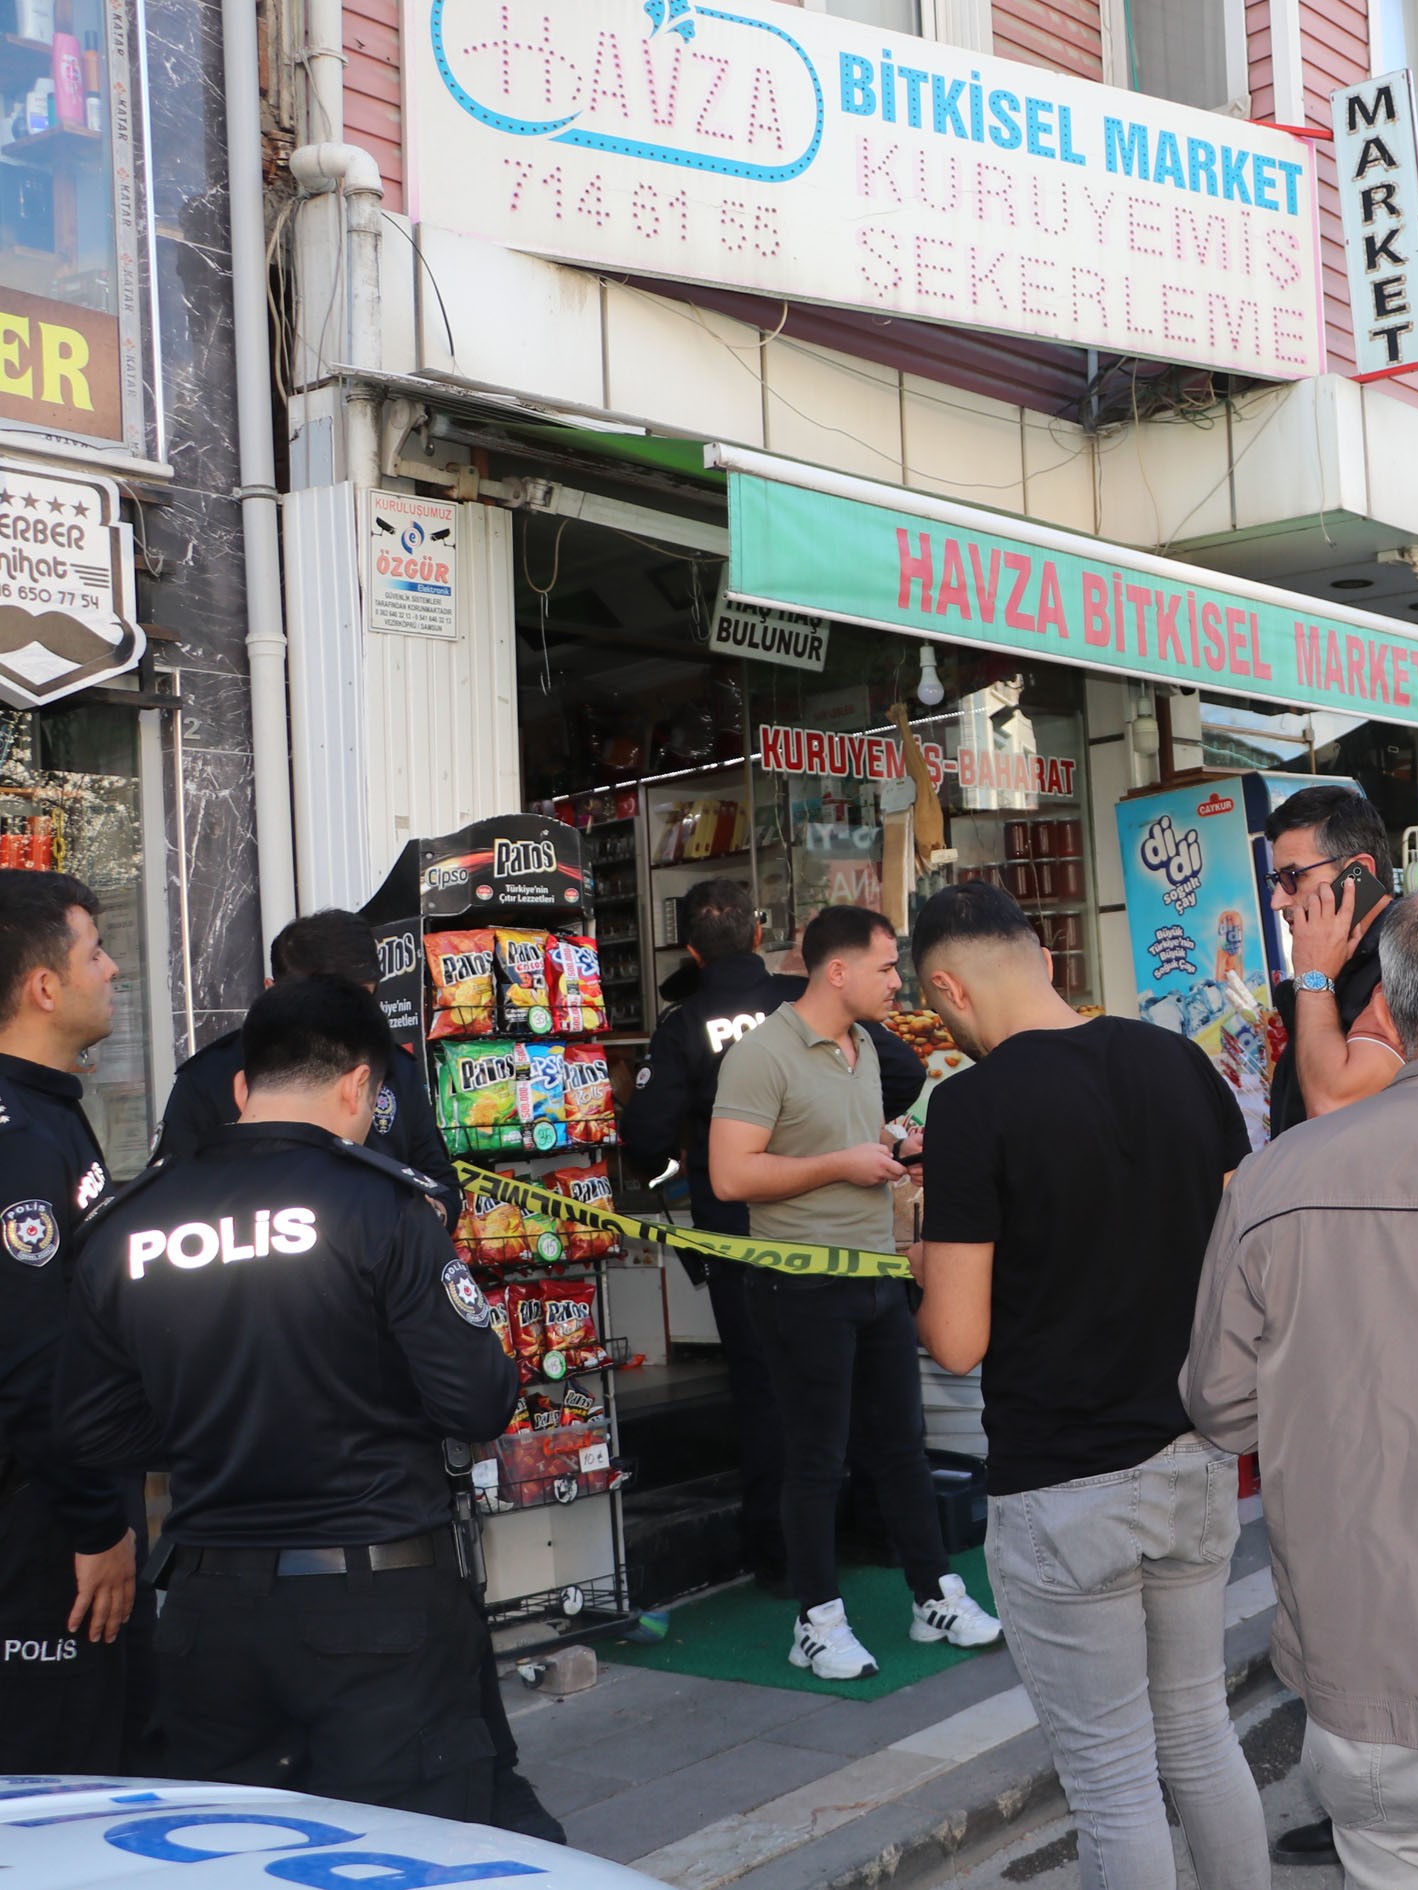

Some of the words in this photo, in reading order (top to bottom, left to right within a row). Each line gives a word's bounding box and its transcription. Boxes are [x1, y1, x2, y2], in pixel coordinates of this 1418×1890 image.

[461, 2, 785, 150] HAVZA
[839, 48, 1086, 167] BİTKİSEL
[1103, 115, 1303, 216] MARKET
[502, 158, 611, 226] 714
[719, 199, 780, 257] 55
[1345, 83, 1415, 366] MARKET
[375, 498, 452, 520] KURULUŞUMUZ
[376, 549, 449, 584] ÖZGÜR
[18, 586, 51, 603] 650
[58, 591, 75, 606] 77
[81, 593, 99, 609] 54
[897, 528, 1069, 640] HAVZA
[1082, 571, 1273, 682] BİTKİSEL
[716, 615, 823, 662] BULUNUR
[183, 717, 200, 740] 2
[426, 868, 469, 889] Cipso
[505, 884, 549, 895] Türkiye'nin
[517, 894, 555, 904] Lezzetleri
[1163, 877, 1200, 906] soğuk
[1156, 925, 1184, 940] Büyük
[1149, 936, 1196, 956] Türkiye'nin
[1160, 949, 1187, 963] Büyük
[7, 1202, 47, 1219] POLİS
[128, 1207, 317, 1279] POLİS
[4, 1638, 77, 1664] POLİS
